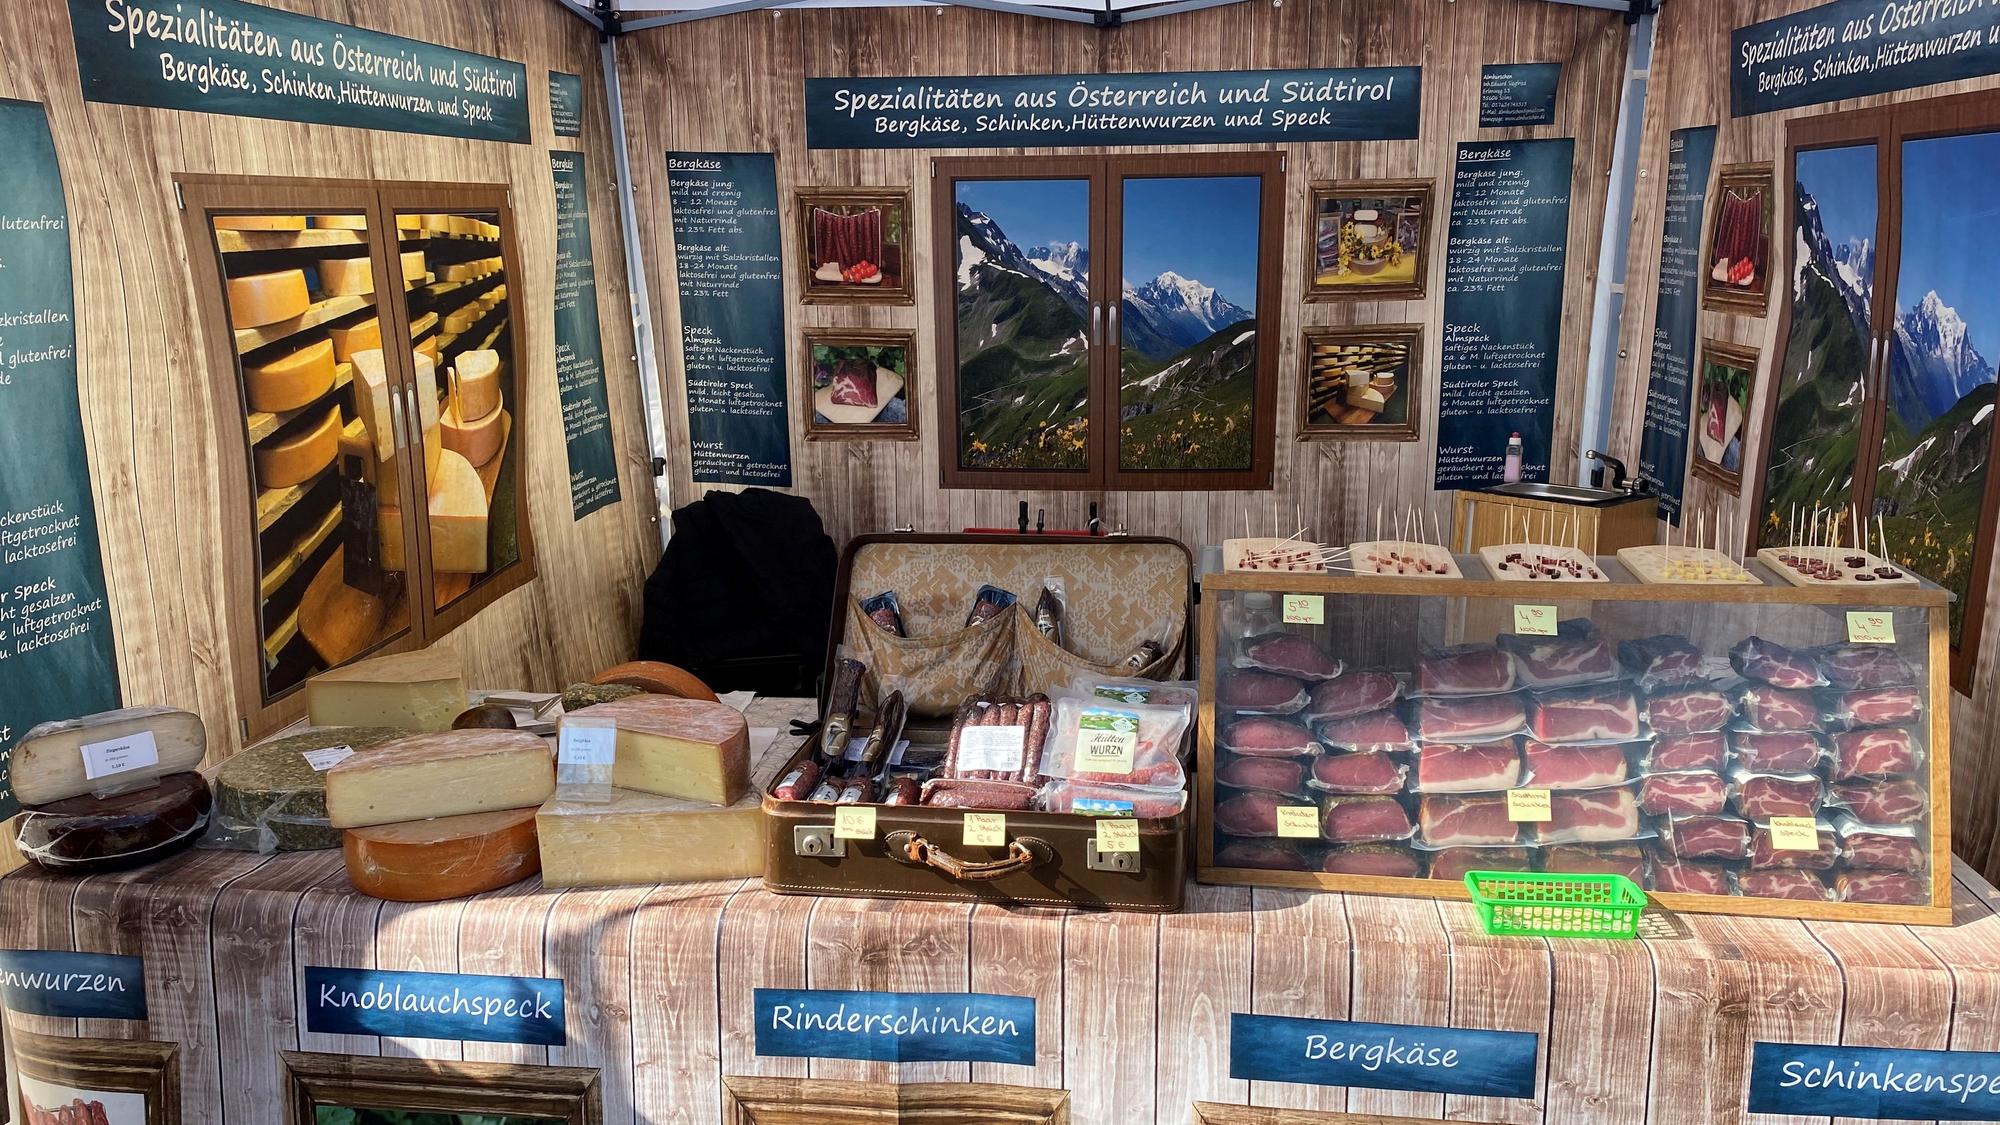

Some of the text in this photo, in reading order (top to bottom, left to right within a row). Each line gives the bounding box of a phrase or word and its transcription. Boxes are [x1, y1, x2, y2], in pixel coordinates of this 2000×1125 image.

[106, 0, 517, 99] Spezialitäten aus Österreich und Südtirol
[1741, 25, 1836, 76] Spezialitäten
[1842, 15, 1873, 43] aus
[1758, 67, 1808, 96] Bergkäse,
[160, 53, 256, 94] Bergkäse,
[438, 96, 459, 116] und
[463, 99, 493, 125] Speck
[834, 76, 1394, 118] Spezialitäten aus Österreich und Südtirol
[875, 114, 967, 137] Bergkäse,
[1224, 108, 1263, 127] und
[1271, 107, 1331, 131] Speck
[1459, 149, 1511, 161] Bergkäse
[669, 159, 721, 170] Bergkäse
[1457, 170, 1496, 180] Bergkäse
[671, 180, 708, 188] Bergkäse
[1456, 179, 1475, 187] mild
[1498, 179, 1529, 187] cremig
[1454, 198, 1498, 207] laktosefrei
[1523, 196, 1567, 206] glutenfrei
[674, 207, 713, 215] laktosefrei
[737, 208, 777, 217] glutenfrei
[1, 215, 65, 230] lutenfrei
[1451, 238, 1491, 247] Bergkäse
[677, 244, 711, 252] Bergkäse
[1503, 245, 1562, 253] Salzkristallen
[1448, 264, 1495, 273] laktosefrei
[1519, 263, 1562, 273] glutenfrei
[740, 272, 780, 281] glutenfrei
[684, 326, 712, 338] Speck
[1445, 323, 1481, 336] Speck
[1445, 334, 1490, 342] Almspeck
[1445, 342, 1534, 351] saftiges Nackenstück
[9, 345, 72, 369] glutenfrei
[719, 355, 774, 363] luftgetrocknet
[1484, 352, 1545, 361] luftgetrocknet
[727, 364, 770, 372] lacktosefrei
[1491, 361, 1540, 369] lacktosefrei
[730, 382, 754, 390] Speck
[1443, 379, 1518, 388] Südtiroler Speck
[1495, 389, 1530, 398] gesalzen
[729, 399, 783, 407] luftgetrocknet
[1487, 397, 1549, 405] luftgetrocknet
[730, 407, 773, 415] lacktosefrei
[1488, 406, 1537, 414] lacktosefrei
[693, 441, 723, 449] Wurst
[1439, 446, 1473, 454] Wurst
[693, 451, 750, 459] Hüttenwurzen
[694, 459, 787, 470] geräuchert getrocknet
[1437, 464, 1484, 473] geräuchert
[0, 514, 80, 547] ftgetrocknet
[4, 532, 76, 564] lacktosefrei
[14, 576, 56, 602] Speck
[21, 593, 75, 620] gesalzen
[12, 598, 101, 637] luftgetrocknet
[17, 617, 90, 654] lacktosefrei
[1090, 745, 1123, 755] WURZN
[320, 982, 552, 1025] Knoblauchspeck
[772, 1003, 1018, 1036] Rinderschinken
[1304, 1034, 1459, 1071] Bergkäse
